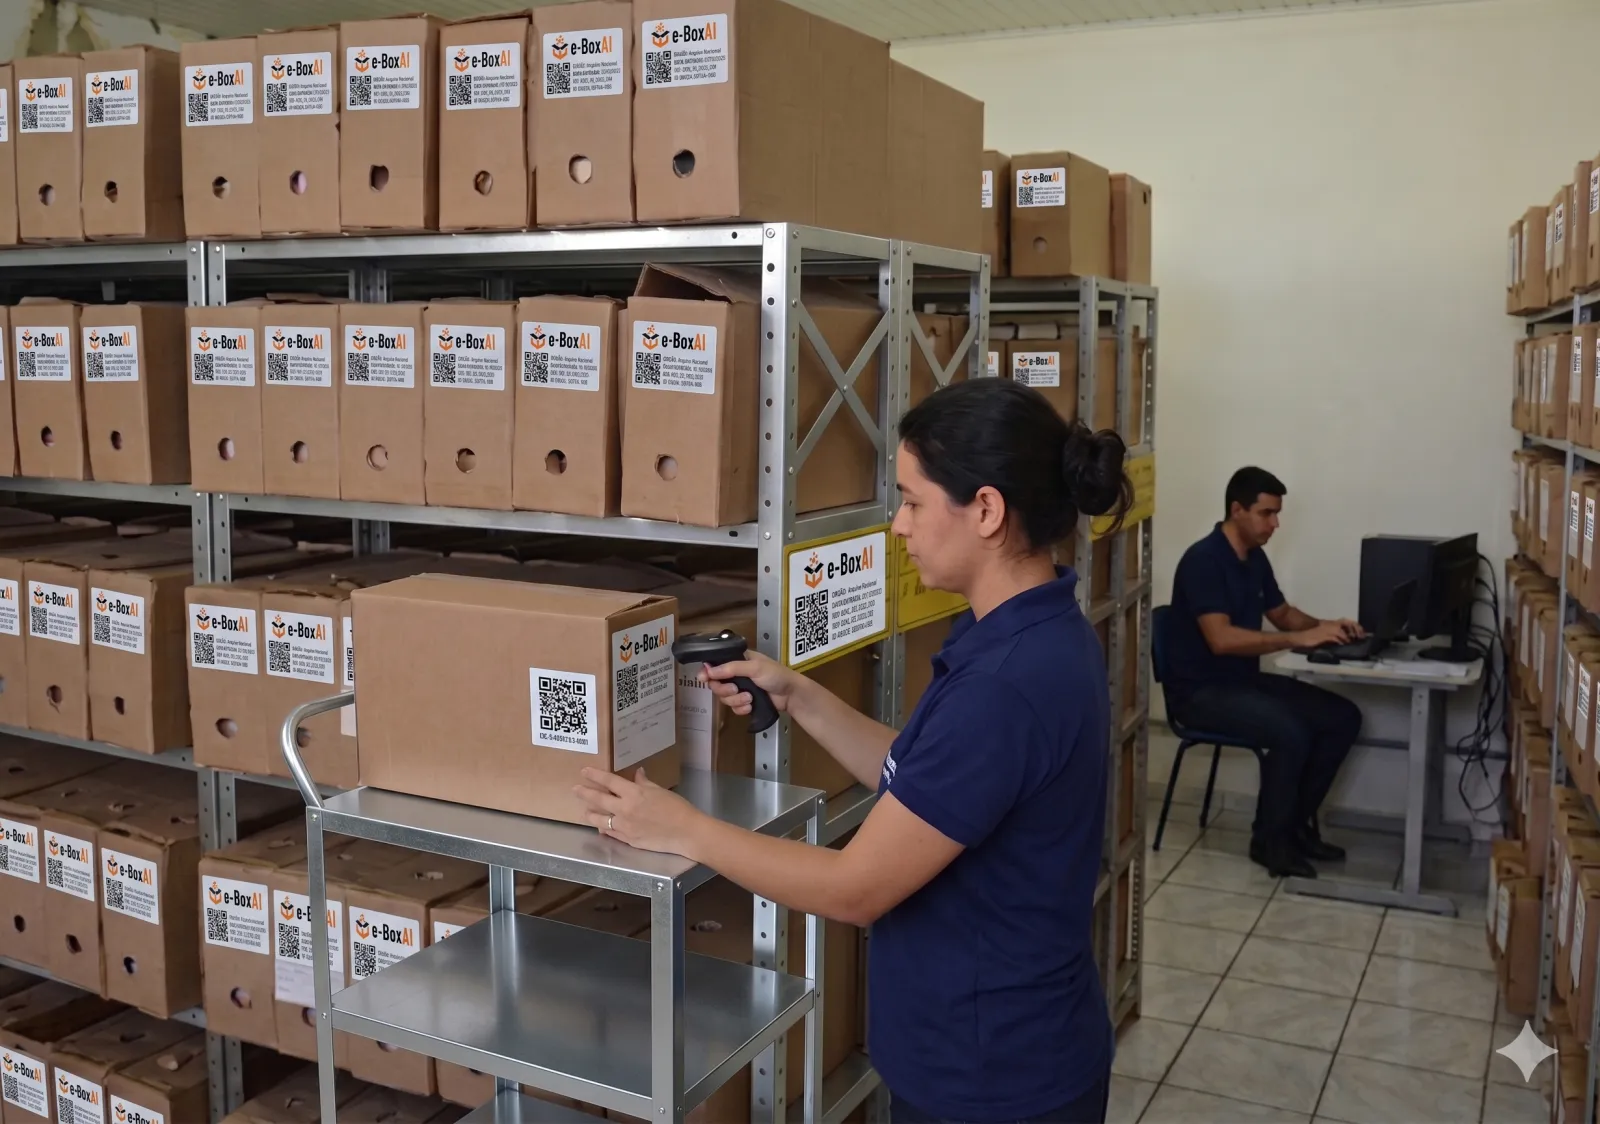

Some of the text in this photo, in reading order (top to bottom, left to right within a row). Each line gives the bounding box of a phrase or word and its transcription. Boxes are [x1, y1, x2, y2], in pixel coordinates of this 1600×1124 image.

[672, 22, 717, 43] e-BoxAI
[571, 36, 612, 55] e-BoxAI
[287, 59, 323, 76] e-BoxAI
[372, 52, 410, 69] e-BoxAI
[472, 50, 511, 68] e-BoxAI
[103, 76, 132, 91] e-BoxAI
[208, 69, 244, 86] e-BoxAI
[37, 84, 66, 98] e-BoxAI
[1033, 172, 1059, 184] e-BoxAI
[34, 333, 63, 347] e-BoxAI
[101, 332, 130, 347] e-BoxAI
[212, 335, 246, 350] e-BoxAI
[288, 334, 323, 350] e-BoxAI
[369, 334, 406, 350] e-BoxAI
[456, 333, 495, 350] e-BoxAI
[549, 332, 590, 349] e-BoxAI
[662, 332, 706, 350] e-BoxAI
[1029, 356, 1055, 367] e-BoxAI
[827, 545, 873, 579] e-BoxAI
[45, 592, 73, 609] e-BoxAI
[108, 599, 138, 617] e-BoxAI
[212, 614, 248, 632] e-BoxAI
[288, 622, 325, 641] e-BoxAI
[634, 626, 668, 655] e-BoxAI
[5, 828, 34, 847] e-BoxAI
[60, 844, 88, 864] e-BoxAI
[120, 864, 152, 886] e-BoxAI
[224, 890, 262, 911] e-BoxAI
[372, 924, 413, 946] e-BoxAI
[14, 1062, 42, 1082] e-BoxAI
[70, 1083, 99, 1106] e-BoxAI
